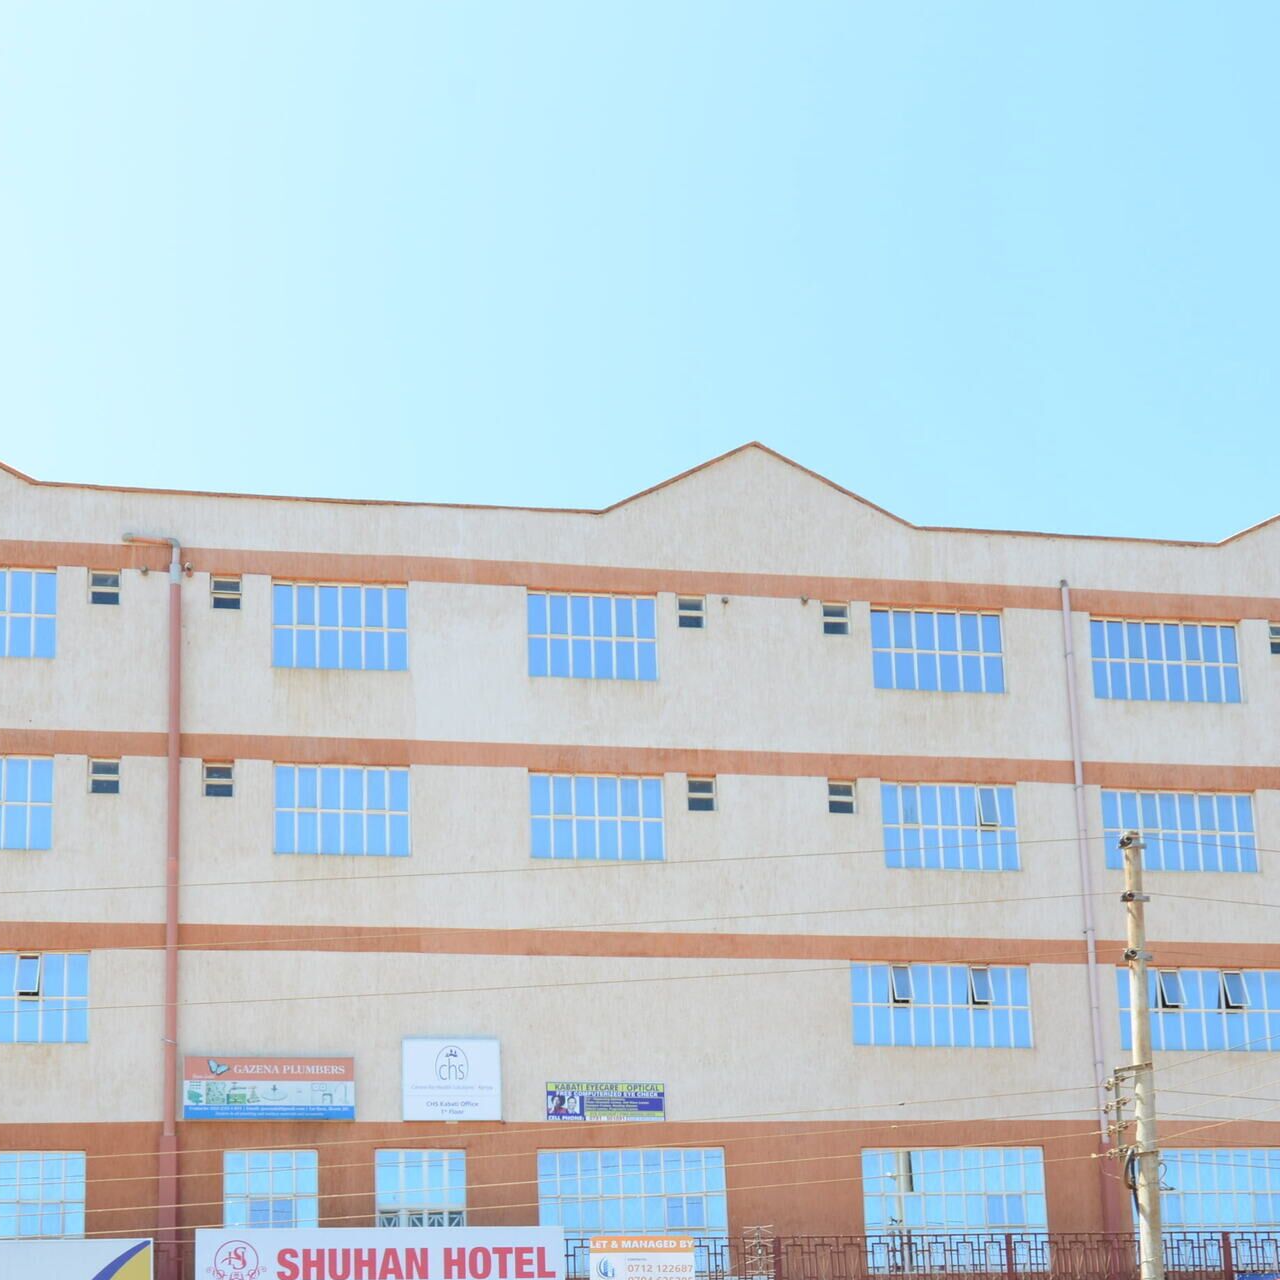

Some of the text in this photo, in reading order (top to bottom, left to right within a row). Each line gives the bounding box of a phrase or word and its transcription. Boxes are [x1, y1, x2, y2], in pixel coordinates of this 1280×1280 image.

[233, 1064, 346, 1075] GAZENA PLUMBERS
[438, 1058, 465, 1081] chs
[554, 1083, 659, 1091] KABATI EYECARE OPTICAL
[590, 1240, 694, 1249] LET & MANAGED BY
[276, 1247, 428, 1280] SHUHAN
[443, 1246, 556, 1280] HOTEL
[627, 1264, 694, 1273] 0712 122687
